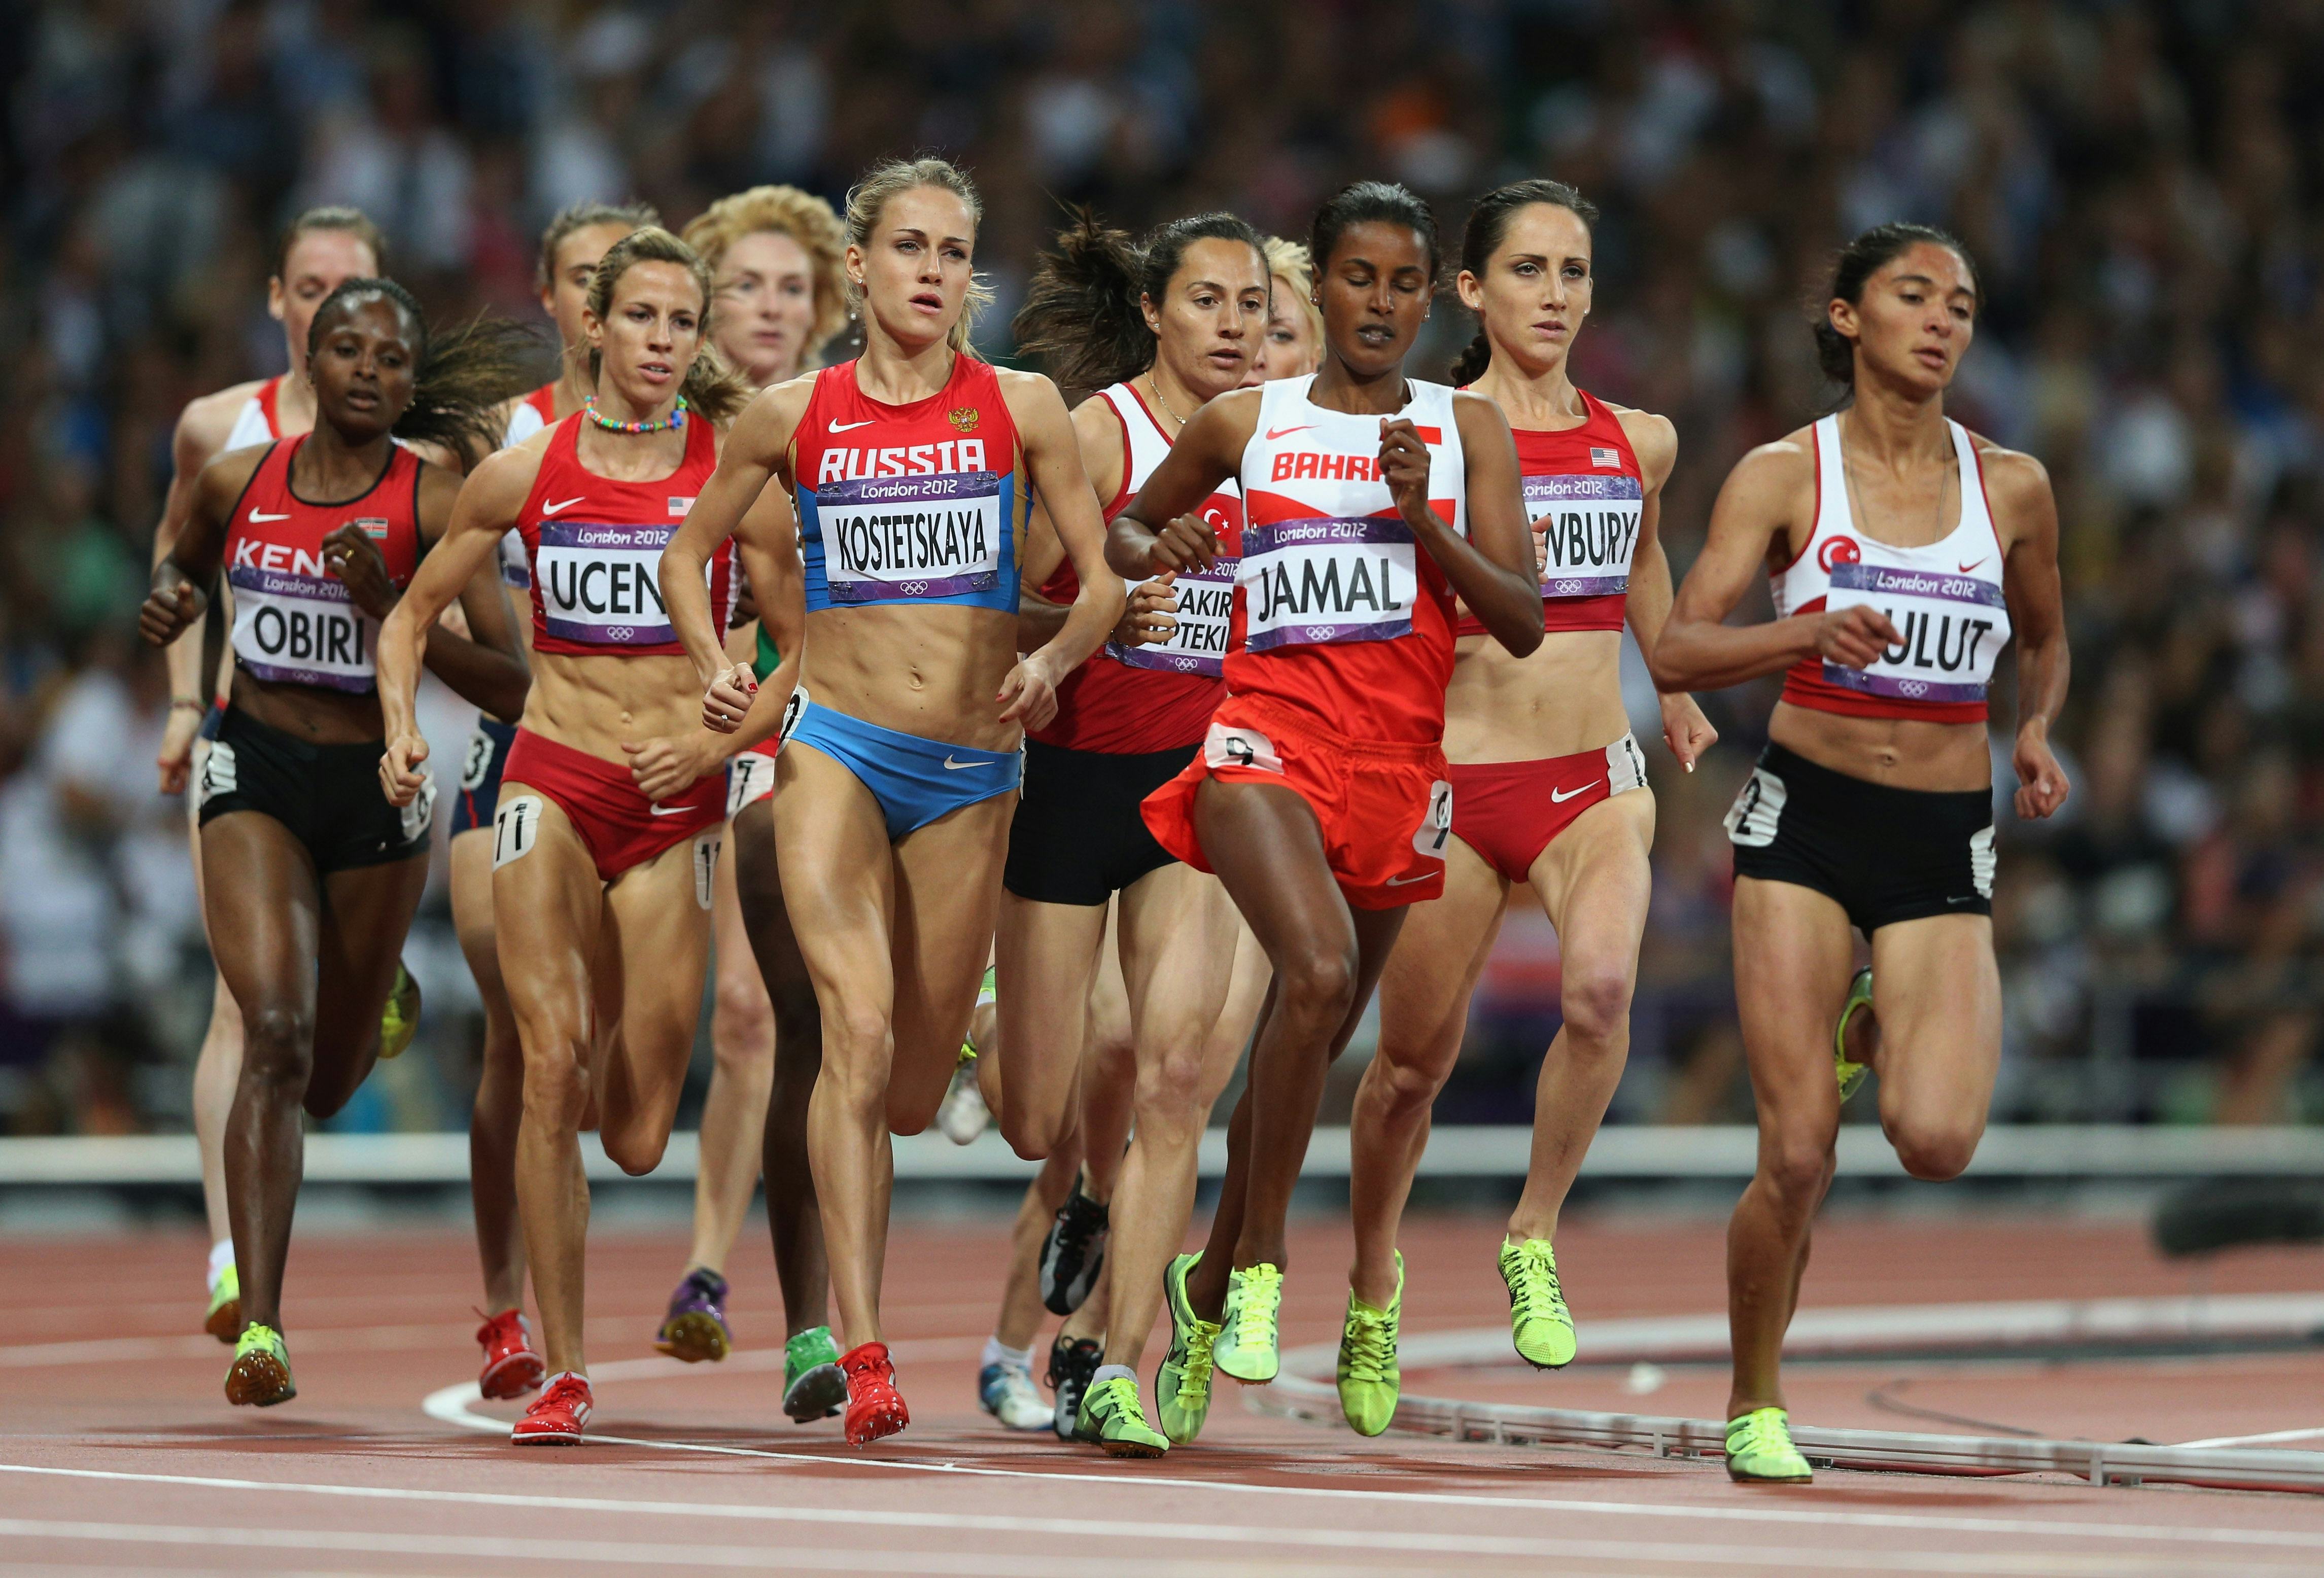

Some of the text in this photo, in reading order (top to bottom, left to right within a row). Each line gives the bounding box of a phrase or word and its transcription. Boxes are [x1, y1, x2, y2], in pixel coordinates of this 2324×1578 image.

[818, 438, 986, 484] RUSSIA
[1271, 452, 1385, 482] BAHR
[861, 479, 958, 499] London 2012
[1523, 481, 1603, 497] ondon 2012
[577, 528, 670, 545] London 2012
[835, 508, 988, 572] KOSTETSKAYA
[1274, 522, 1367, 544] London 2012
[1531, 512, 1638, 567] WBURY
[234, 537, 325, 578] KEN
[263, 574, 316, 595] London
[550, 560, 667, 614] UCEN
[1171, 586, 1232, 618] AKIR
[1258, 557, 1401, 622] JAMAL
[1877, 571, 1976, 598] London 2012
[255, 606, 364, 665] OBIRI
[1880, 608, 1993, 672] ULUT
[496, 803, 528, 862] 11
